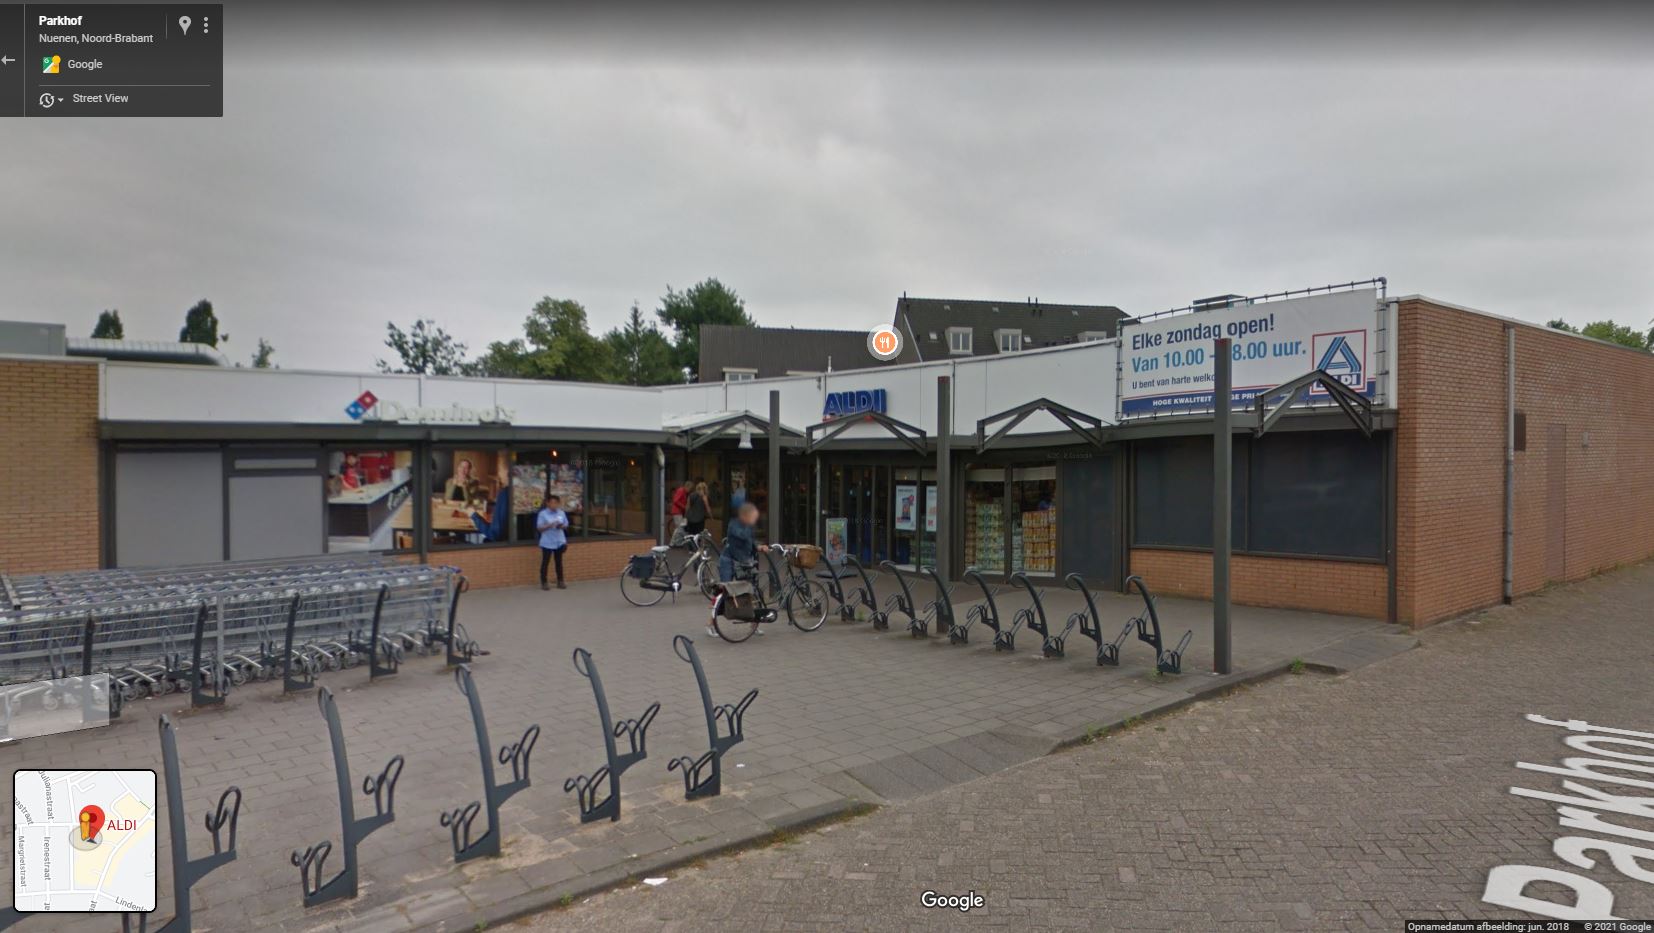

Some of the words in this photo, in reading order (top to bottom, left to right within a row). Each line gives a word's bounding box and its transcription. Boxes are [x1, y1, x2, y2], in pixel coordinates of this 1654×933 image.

[1132, 332, 1162, 350] Elke
[1166, 322, 1221, 344] zondag
[1226, 314, 1274, 339] open!
[1132, 356, 1159, 373] Van
[1163, 347, 1205, 369] 10.00
[1232, 341, 1268, 361] 8.00
[1272, 340, 1307, 358] uur.
[1132, 381, 1138, 390] U
[1139, 379, 1155, 389] bent
[1156, 379, 1170, 387] van
[1171, 376, 1191, 385] harte
[1192, 373, 1215, 383] welko
[823, 389, 887, 417] ALDI
[1152, 398, 1172, 407] HOGE
[1174, 396, 1212, 405] KWALITEIT
